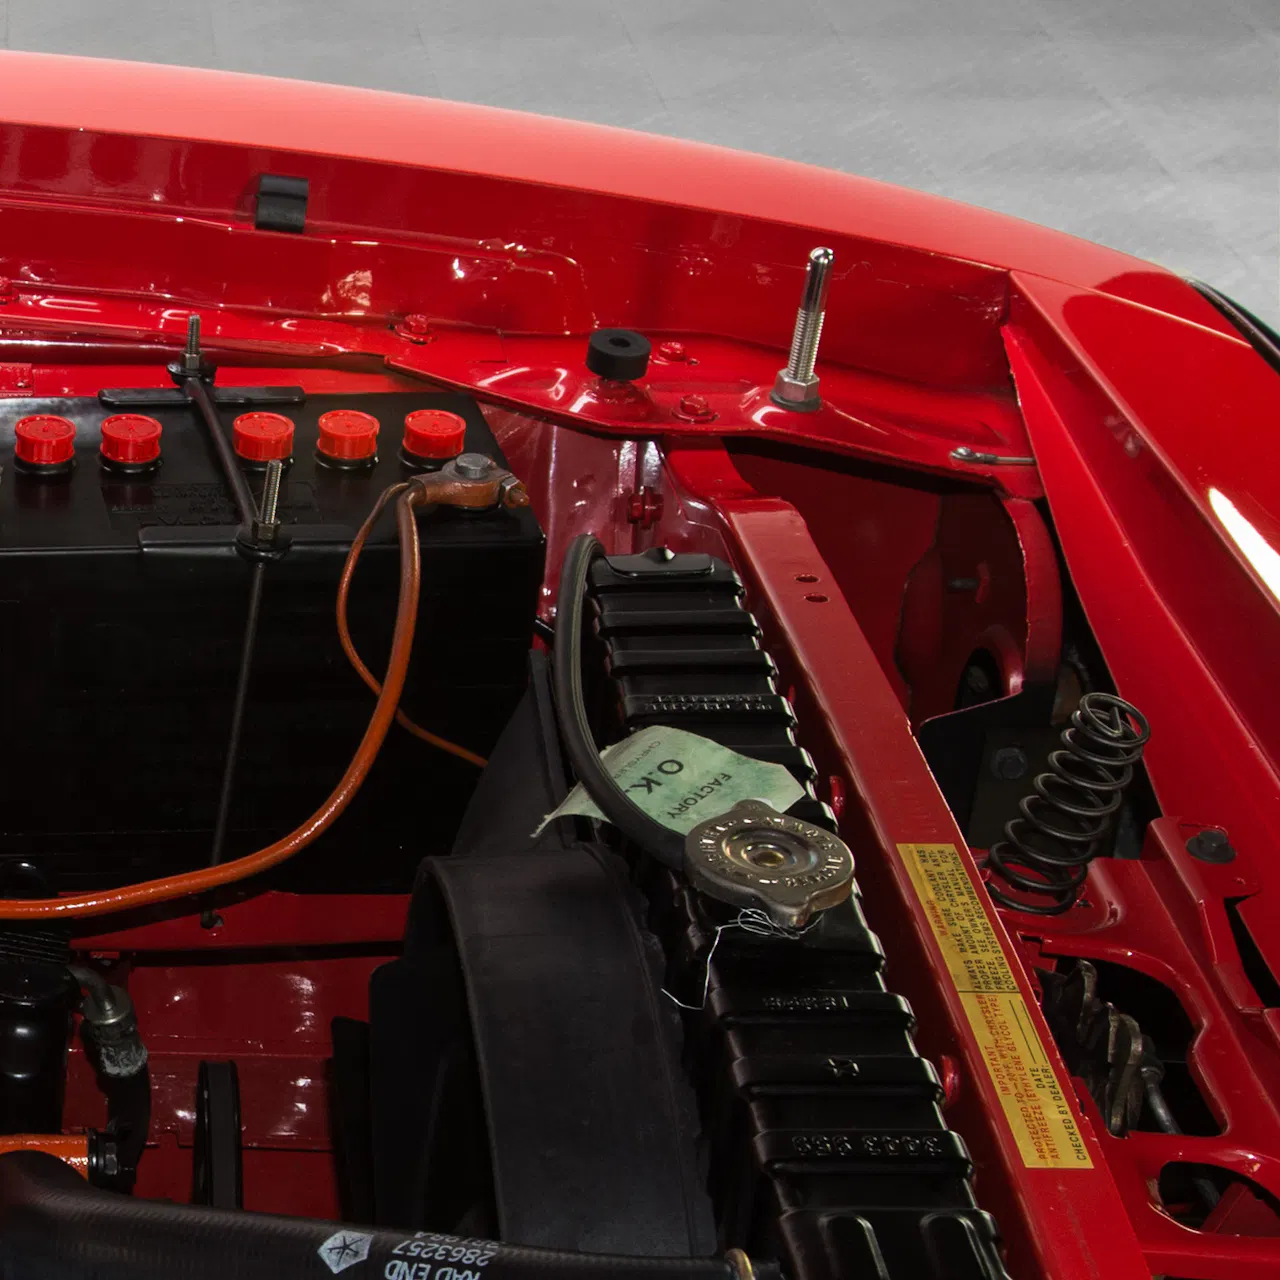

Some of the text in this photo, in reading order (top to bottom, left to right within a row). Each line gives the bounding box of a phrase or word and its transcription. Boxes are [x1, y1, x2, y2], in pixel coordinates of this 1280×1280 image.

[668, 772, 733, 819] FACTORY
[937, 850, 949, 863] FOR
[937, 871, 959, 907] CHRYSLER
[946, 868, 966, 896] MANUAL
[917, 850, 985, 990] ALWAYS MAKE SURE COOLANT HAS
[926, 900, 949, 936] WARNING
[954, 912, 965, 921] OF
[960, 925, 980, 954] AMOUNT
[978, 939, 990, 953] SEE
[980, 921, 1001, 954] SYSTEMS
[974, 959, 994, 990] PROPER
[995, 956, 1017, 991] COOLING
[975, 994, 1000, 1037] CHRYSLER
[998, 1020, 1017, 1051] GLYCOL
[985, 1046, 1011, 1095] IMPORTANT
[1011, 1055, 1040, 1102] (ETHYLENE
[1029, 1067, 1046, 1089] DATE
[1015, 1092, 1024, 1104] TO
[1056, 1104, 1068, 1115] BY
[1020, 1106, 1047, 1160] PROTECTED
[1031, 1105, 1060, 1160] ANTIFREEZE
[1062, 1118, 1087, 1161] CHECKED
[391, 1240, 497, 1267] 2863257
